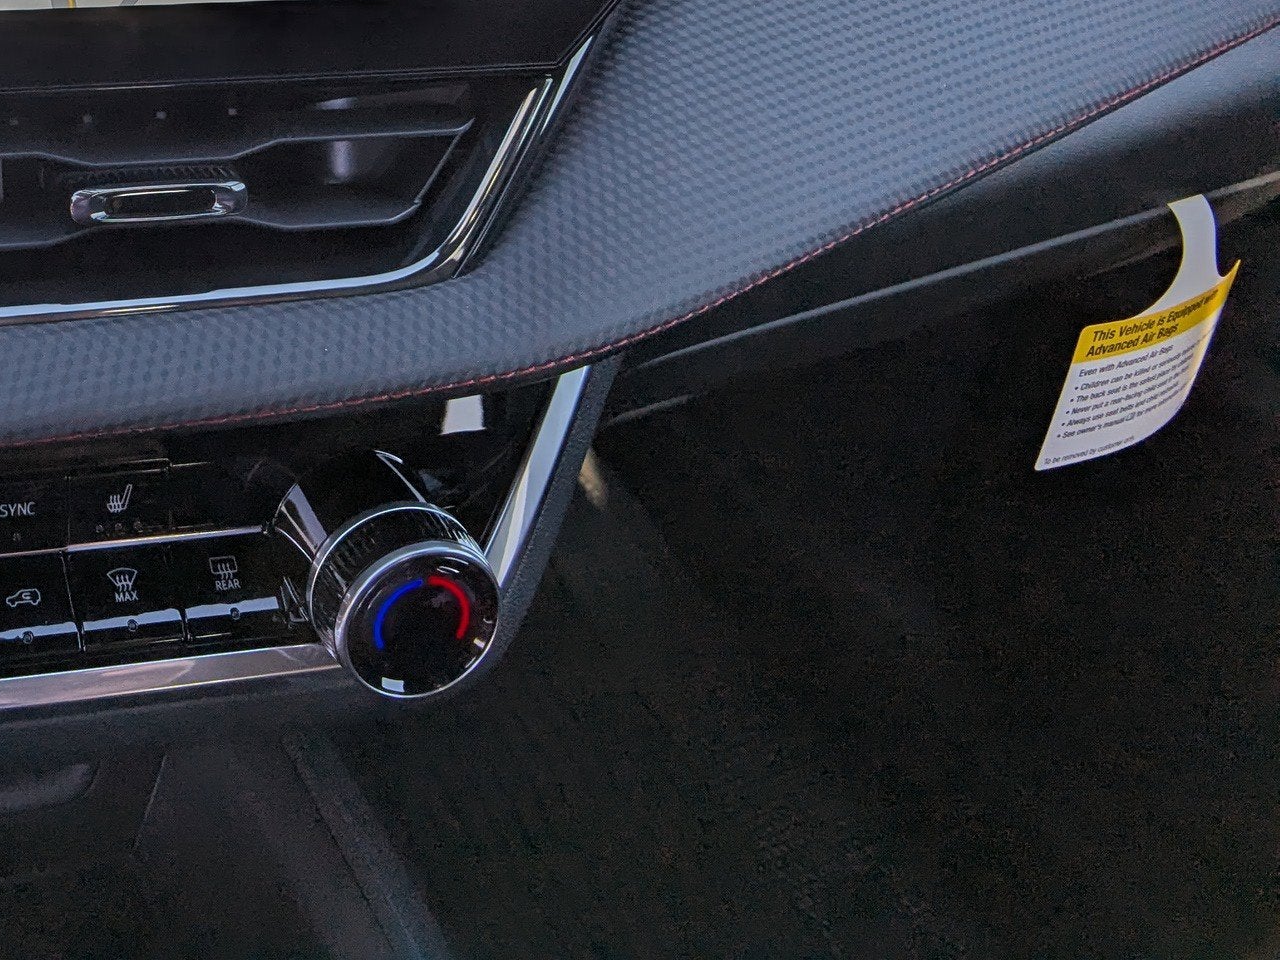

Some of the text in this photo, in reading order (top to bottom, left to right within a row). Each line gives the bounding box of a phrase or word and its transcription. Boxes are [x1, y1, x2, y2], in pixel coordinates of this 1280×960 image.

[1093, 328, 1116, 343] This
[1119, 319, 1156, 337] Vehicle
[1157, 315, 1166, 327] is
[1086, 323, 1179, 358] Advanced Air Bags
[1079, 367, 1098, 378] Even
[1099, 363, 1115, 373] with
[1115, 354, 1148, 370] Advanced
[1080, 378, 1109, 391] Children
[1076, 394, 1088, 403] The
[1062, 429, 1076, 439] See
[0, 501, 36, 518] SYNC
[215, 578, 241, 591] REAR
[114, 590, 139, 603] MAX
